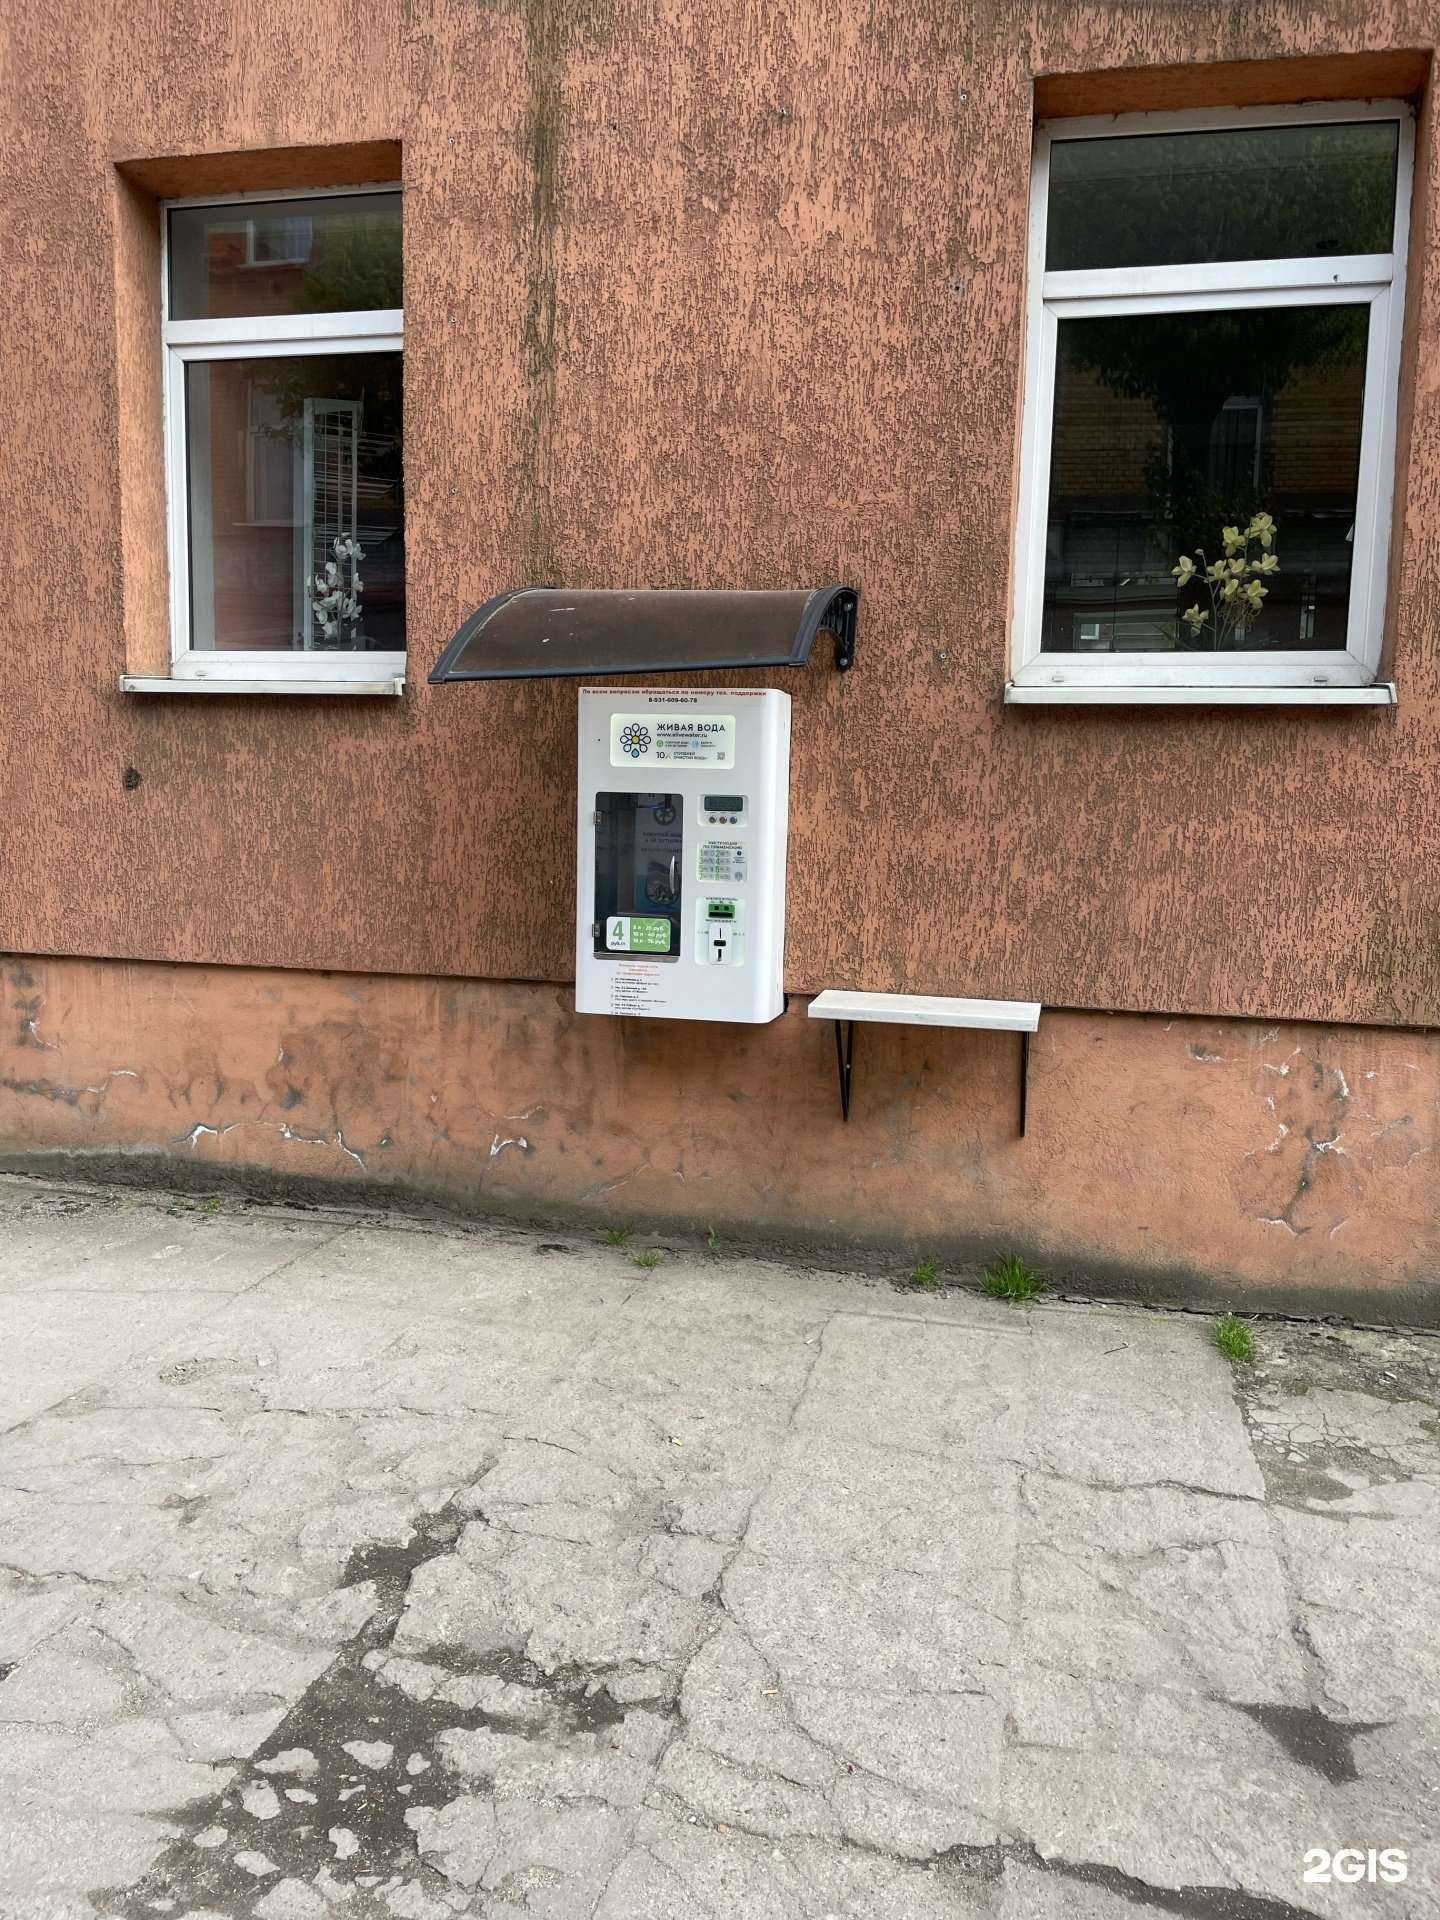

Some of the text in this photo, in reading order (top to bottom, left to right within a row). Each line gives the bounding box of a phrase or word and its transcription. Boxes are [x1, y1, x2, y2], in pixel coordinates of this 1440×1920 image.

[657, 723, 725, 732] ЖИВАЯ ВОДА
[612, 921, 624, 940] 4
